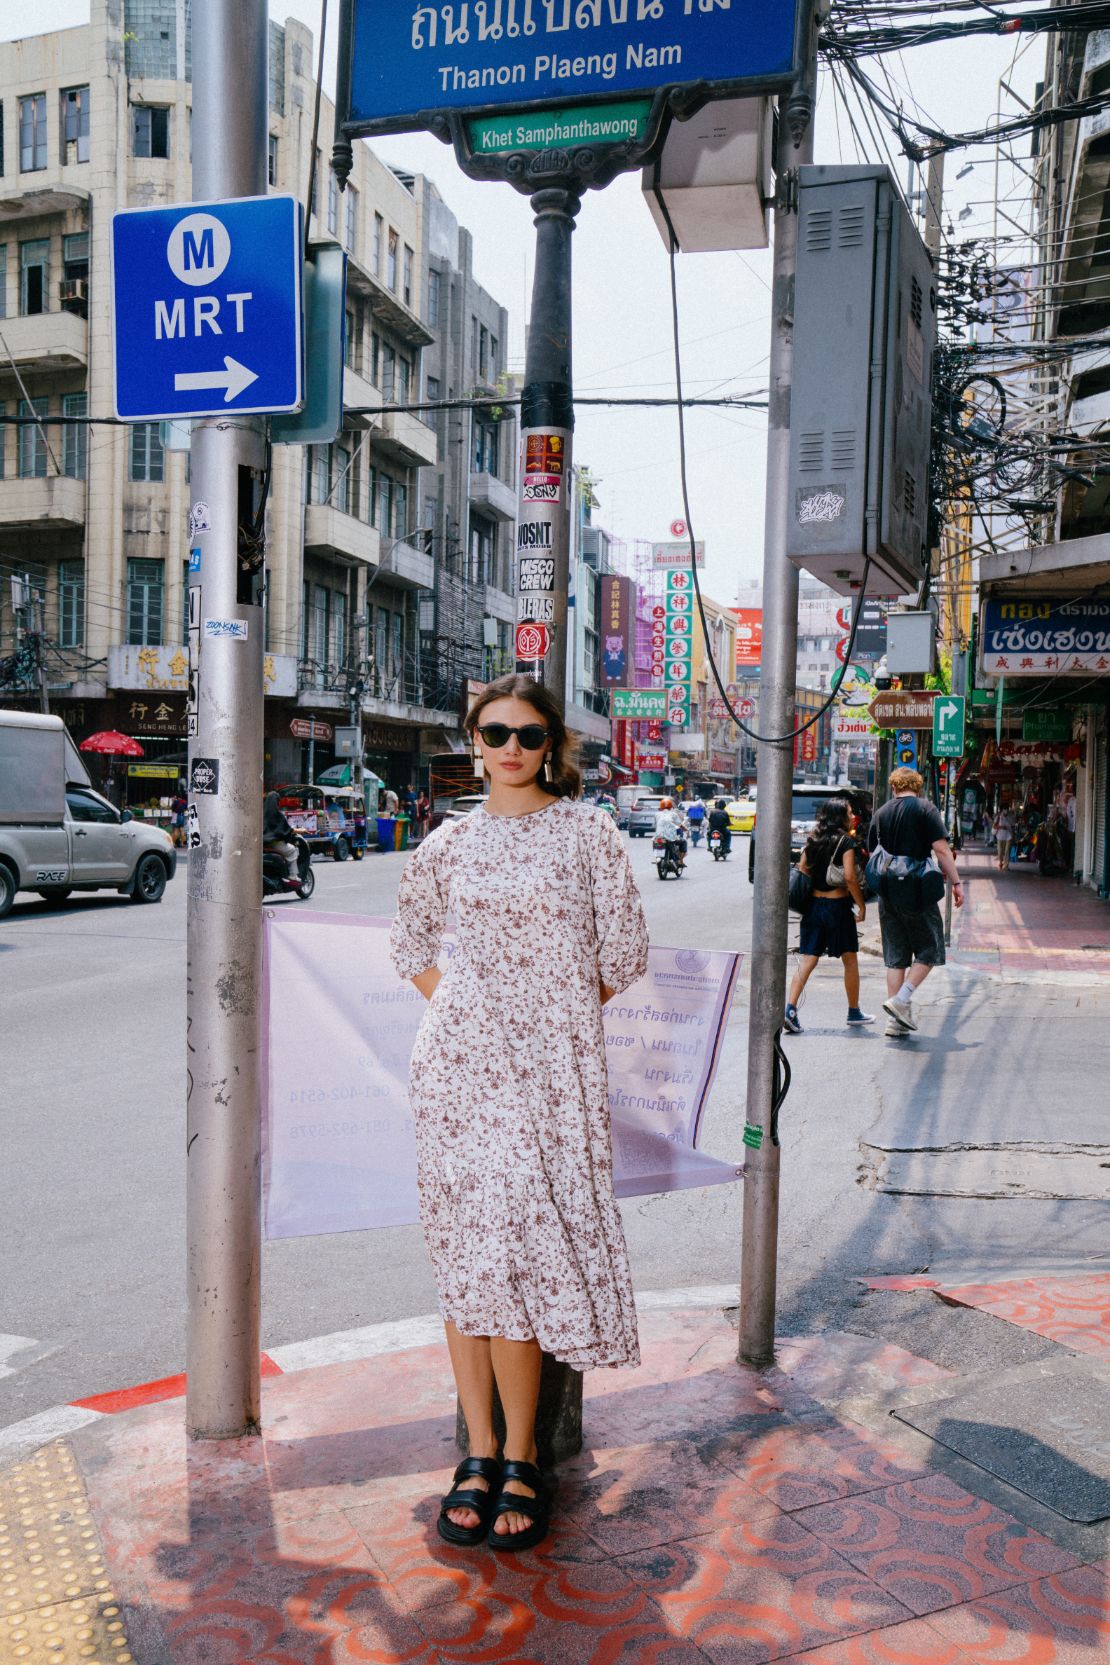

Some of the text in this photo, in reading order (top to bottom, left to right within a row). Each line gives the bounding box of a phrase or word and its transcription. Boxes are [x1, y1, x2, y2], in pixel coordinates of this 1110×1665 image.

[410, 0, 731, 50] ถนนแปลงน
[438, 43, 683, 92] Thanon Plaeng Nam
[481, 116, 639, 148] Khet Samphanthawong
[182, 228, 215, 271] M
[154, 292, 253, 340] MRT
[520, 574, 554, 590] CREW
[1000, 602, 1052, 619] ทอง
